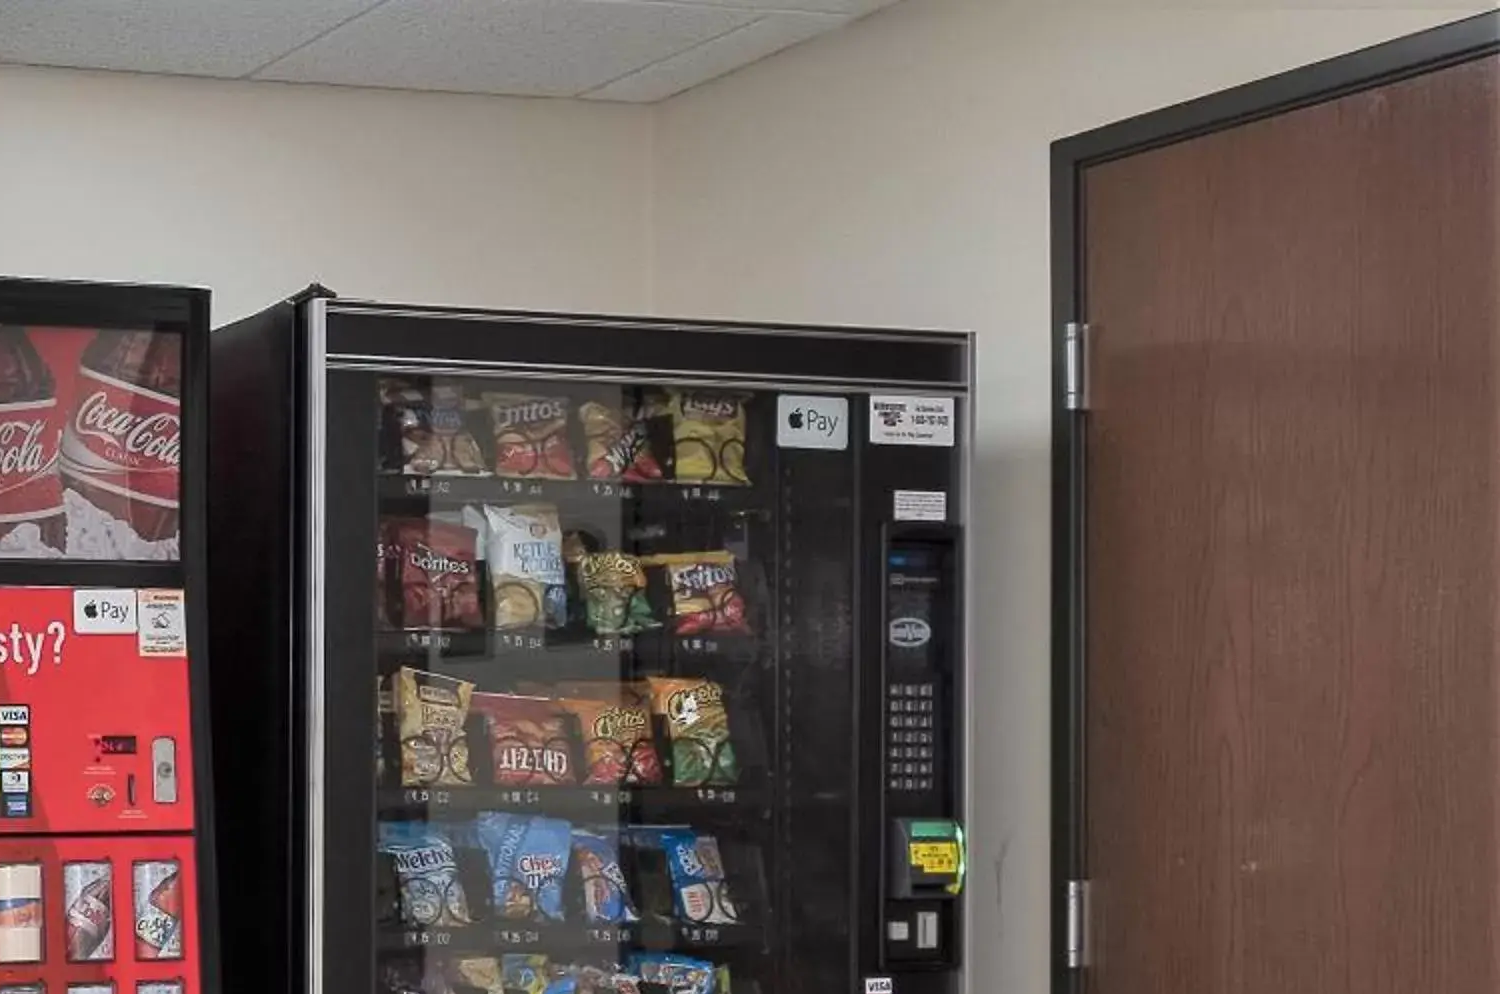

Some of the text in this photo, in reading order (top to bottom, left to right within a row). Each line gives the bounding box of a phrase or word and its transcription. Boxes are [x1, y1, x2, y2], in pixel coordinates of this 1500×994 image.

[807, 410, 839, 437] Pay
[101, 601, 129, 622] Pay
[2, 711, 27, 721] VISA
[868, 981, 891, 992] VISA
